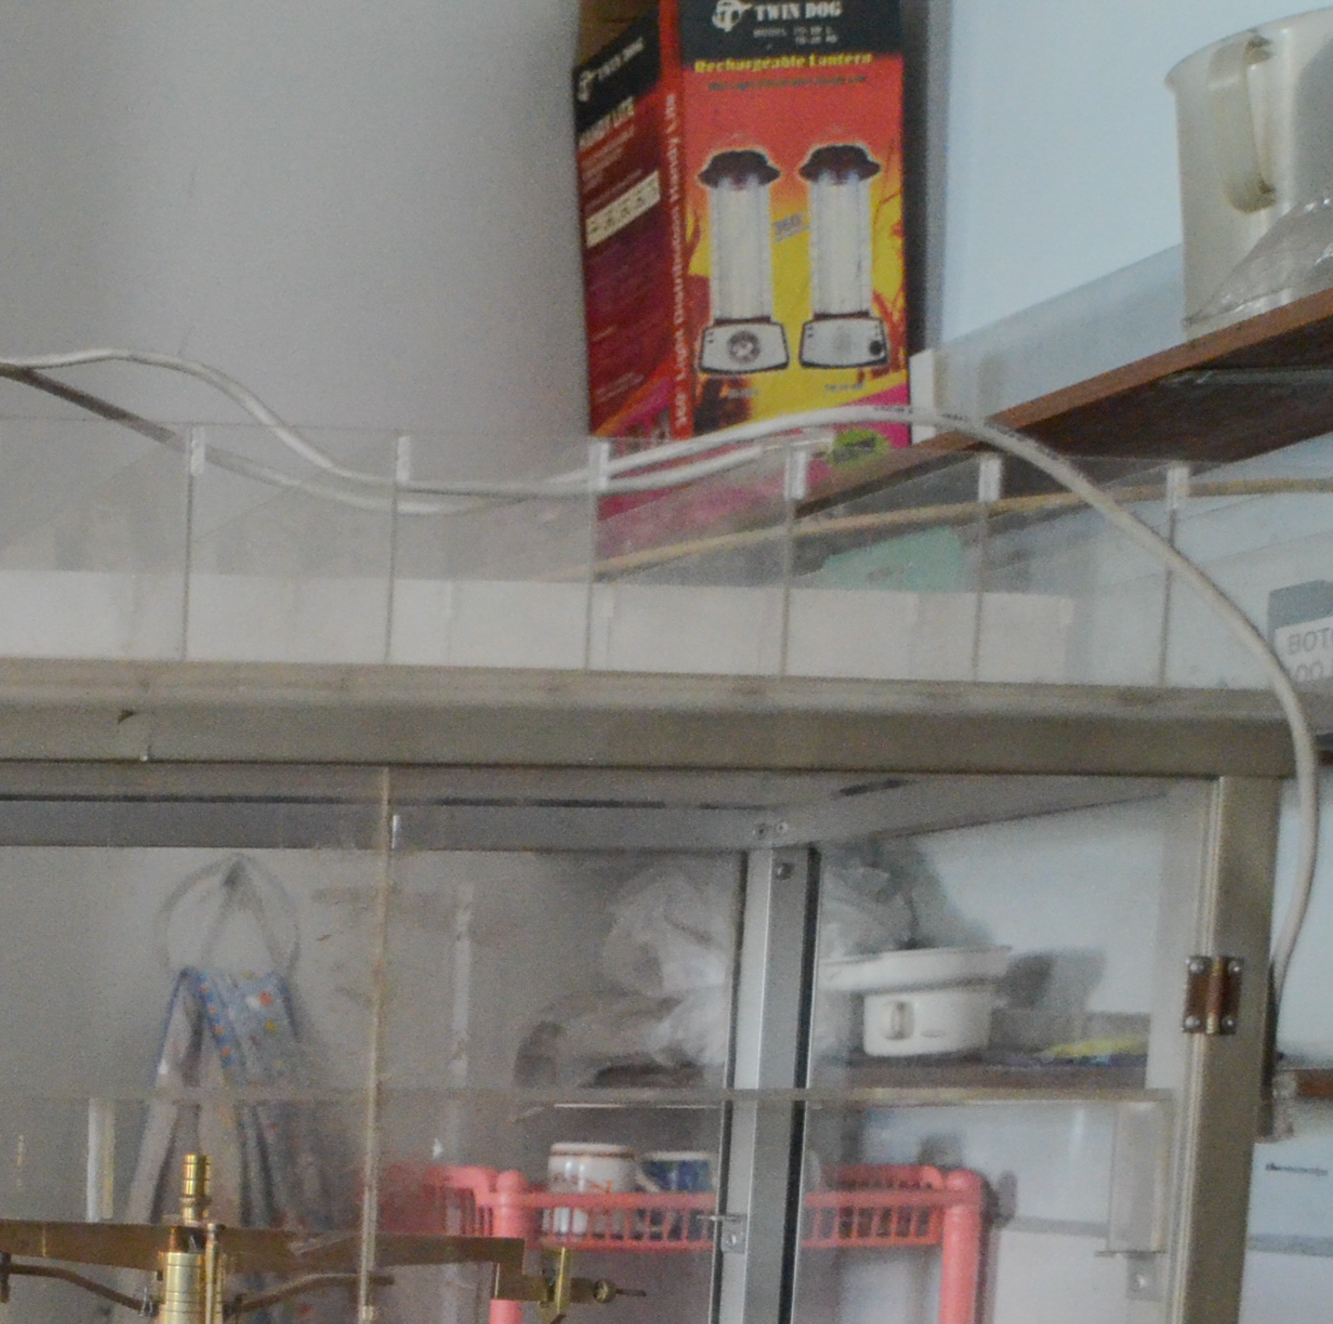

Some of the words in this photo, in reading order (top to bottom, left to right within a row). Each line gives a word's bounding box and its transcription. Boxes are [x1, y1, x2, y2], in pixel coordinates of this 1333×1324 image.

[754, 2, 801, 22] TWIN
[804, 0, 843, 20] DOG
[694, 56, 805, 74] Rechargeable
[809, 53, 874, 69] Lantern
